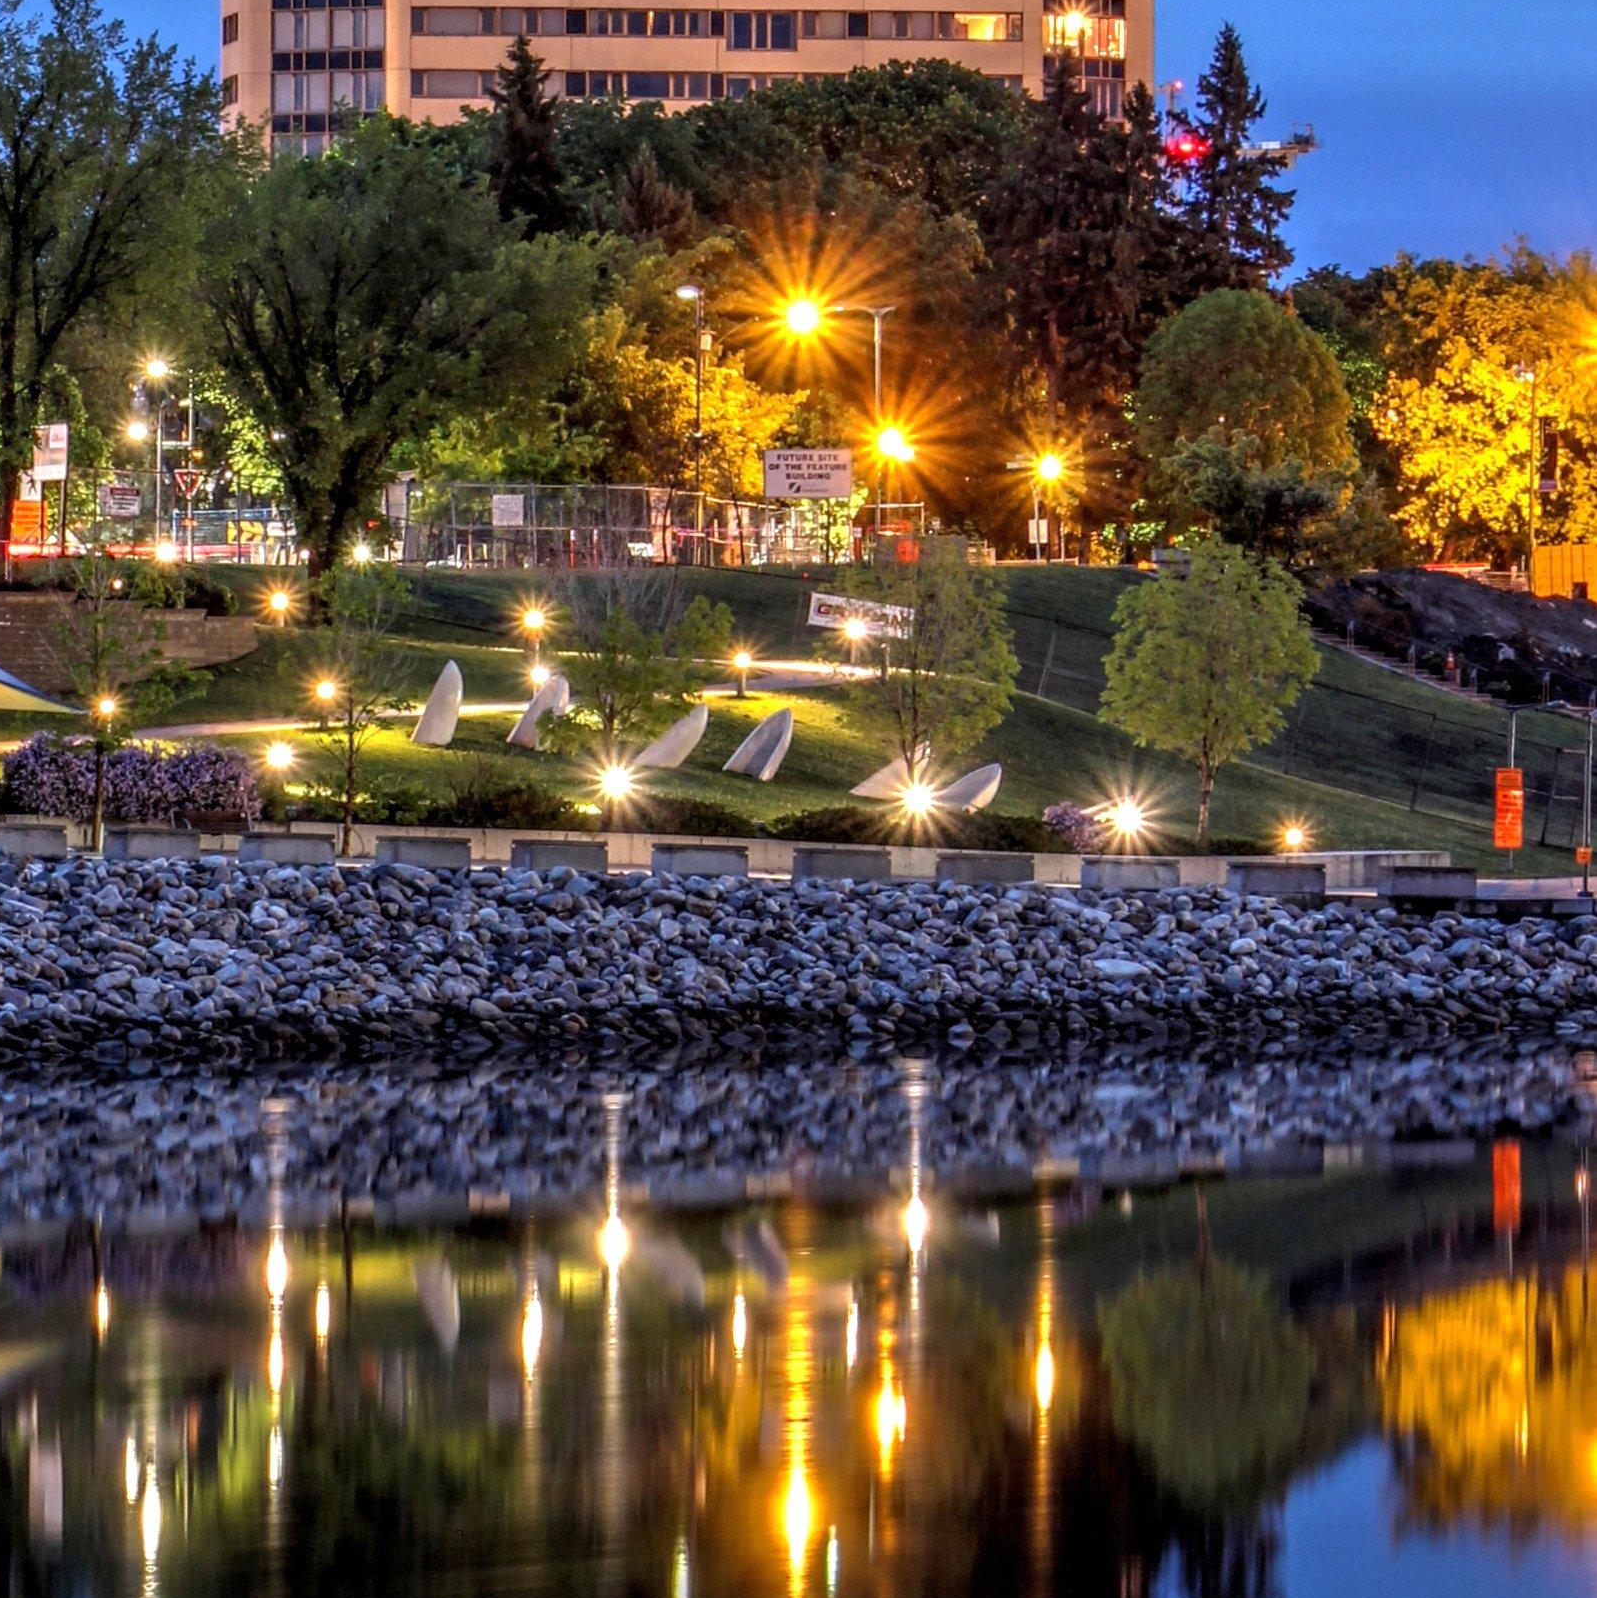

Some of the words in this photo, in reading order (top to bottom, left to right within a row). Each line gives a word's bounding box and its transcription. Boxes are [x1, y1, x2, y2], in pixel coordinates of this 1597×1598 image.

[776, 453, 813, 462] FUTURE
[818, 453, 839, 462] SITE
[768, 463, 780, 471] OF
[785, 463, 802, 471] THE
[806, 463, 847, 471] FEATURE
[785, 472, 831, 480] BUILDING
